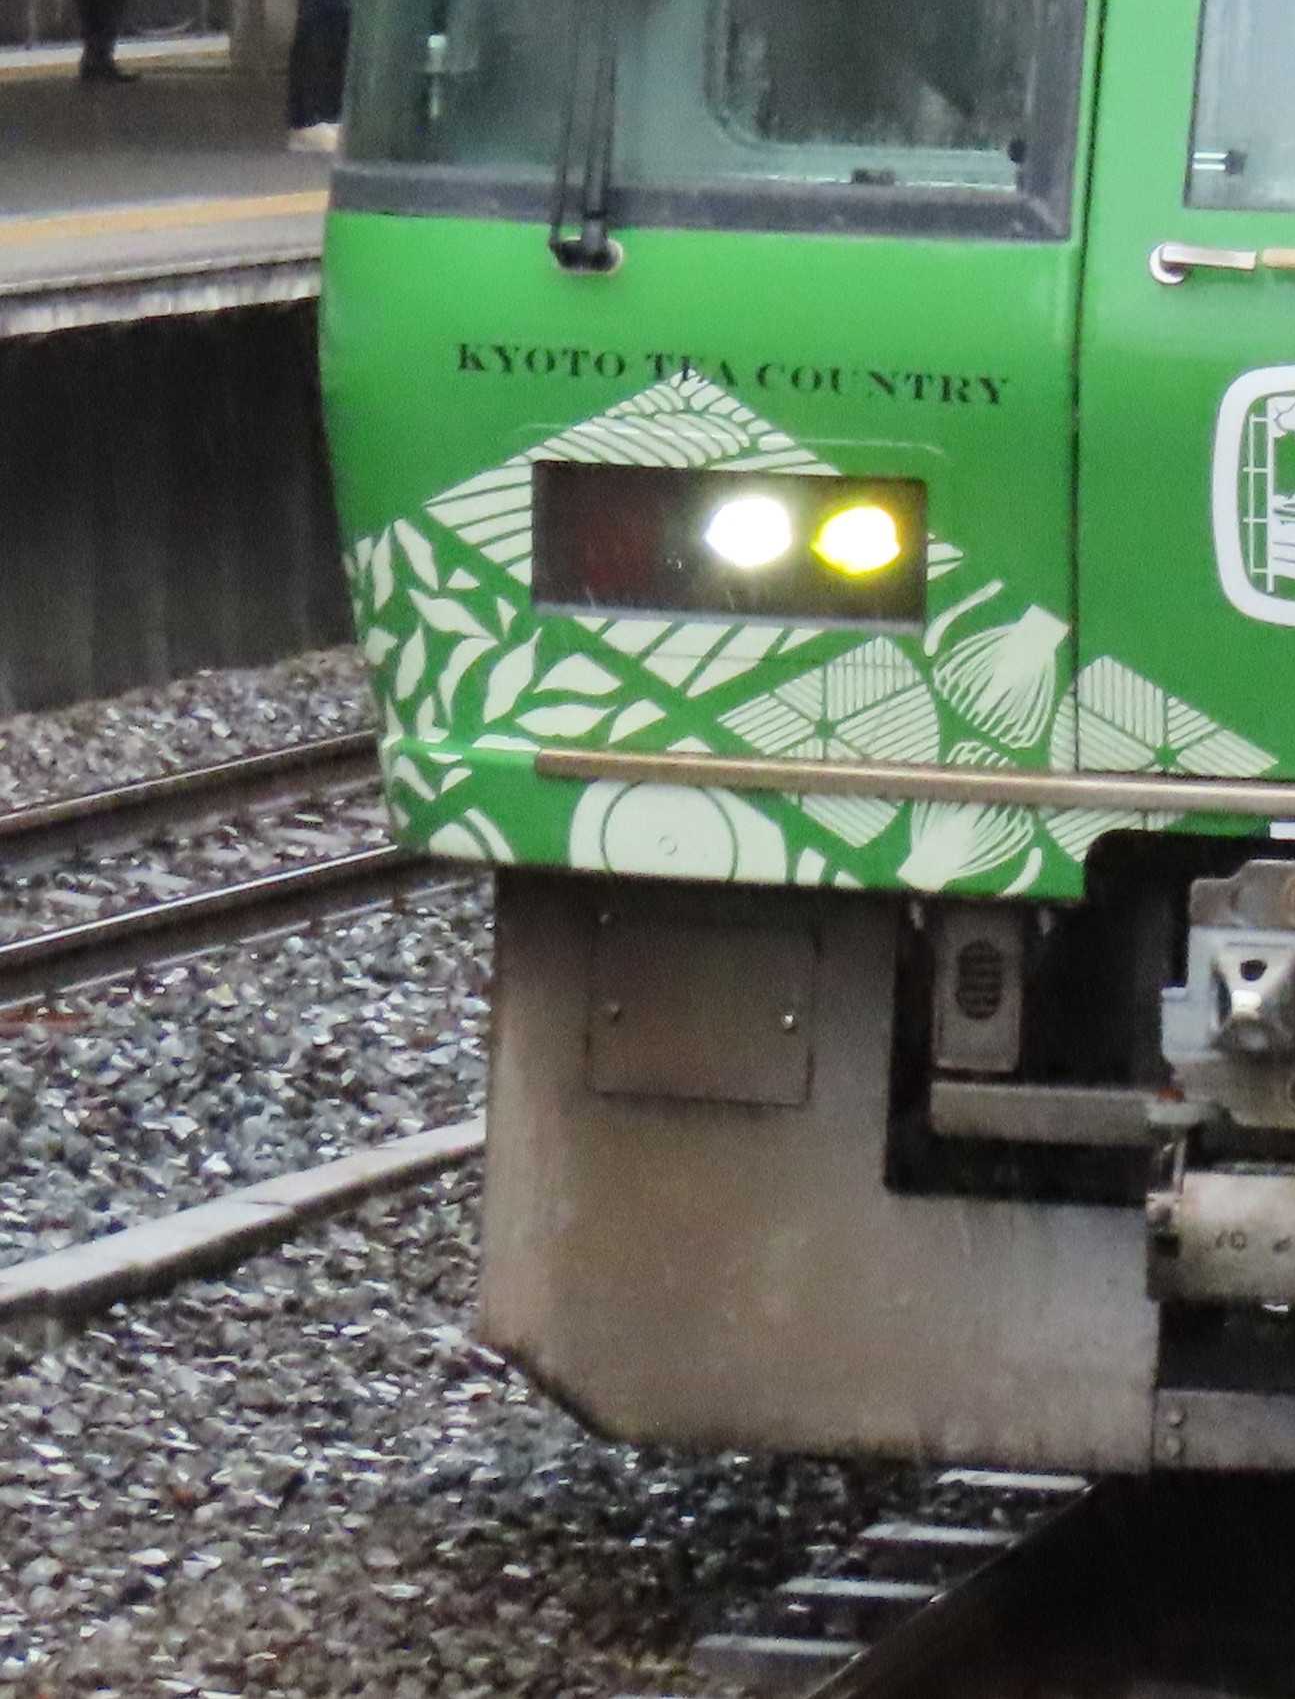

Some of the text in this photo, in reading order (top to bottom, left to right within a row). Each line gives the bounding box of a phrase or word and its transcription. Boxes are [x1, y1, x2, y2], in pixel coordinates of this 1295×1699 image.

[457, 342, 1009, 405] KYOTO TEA COUNTRY
